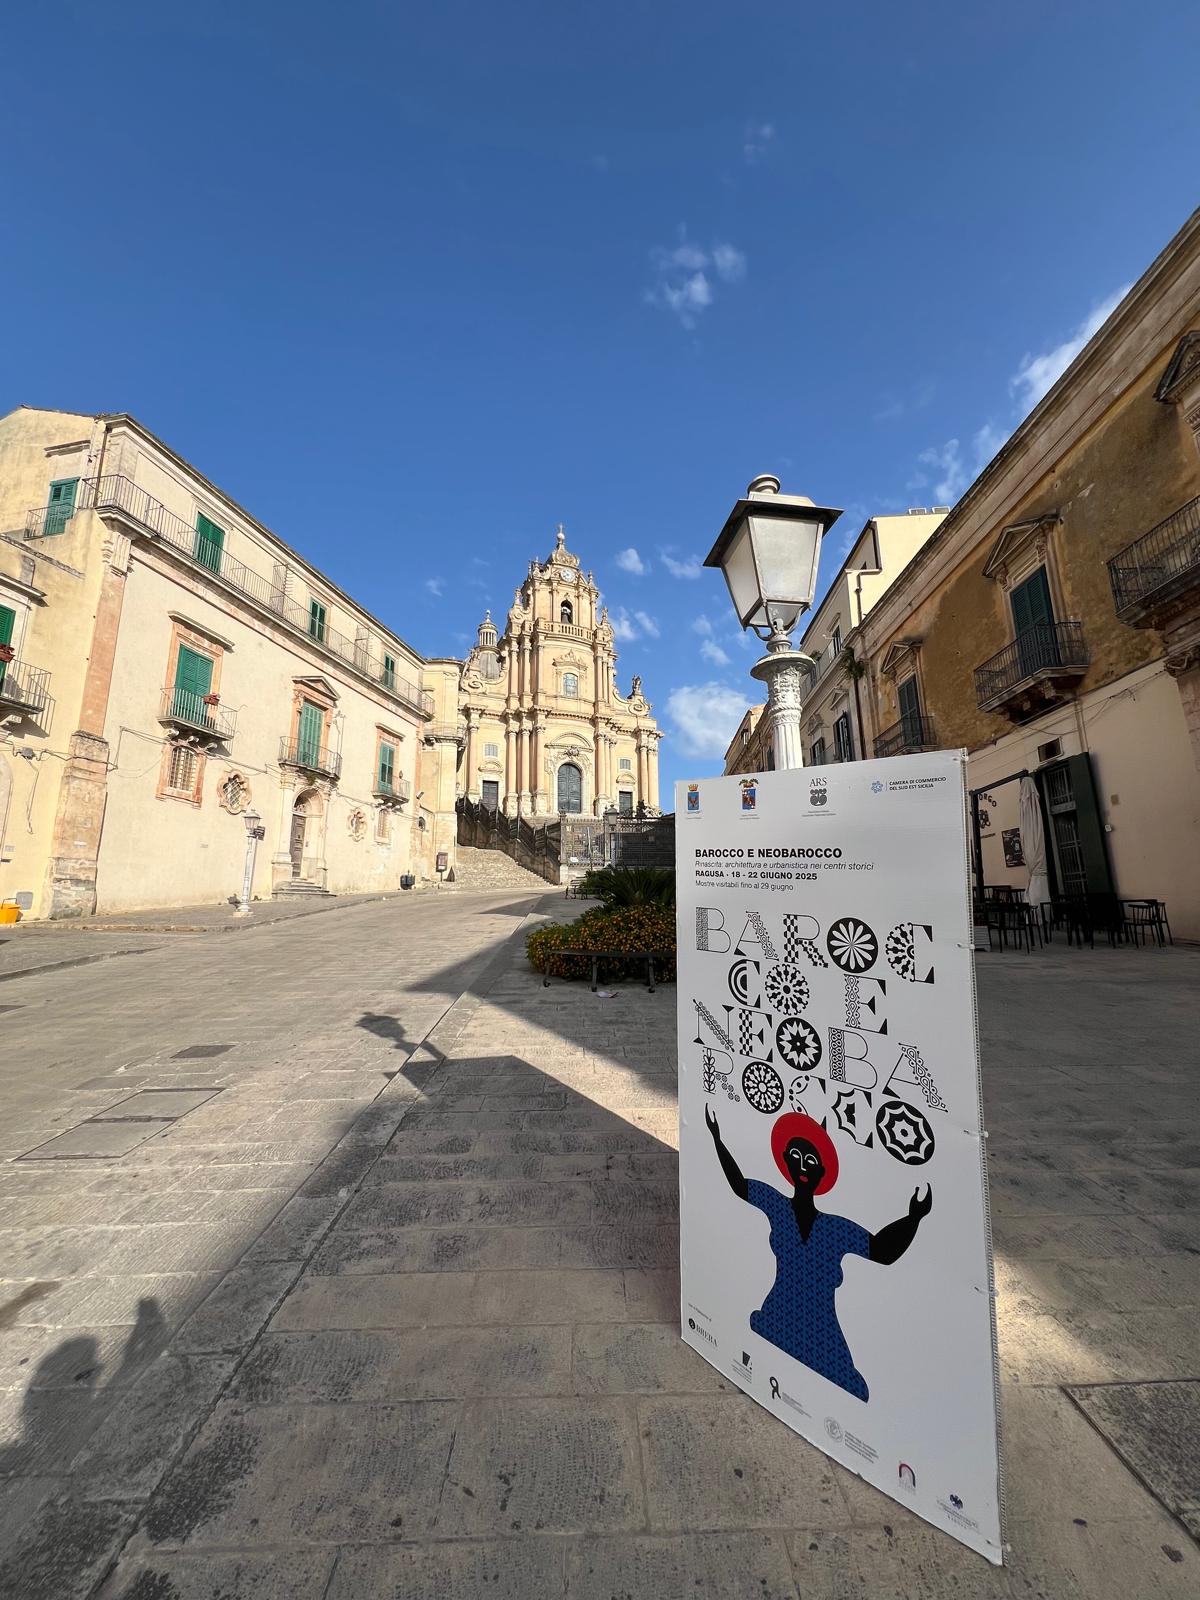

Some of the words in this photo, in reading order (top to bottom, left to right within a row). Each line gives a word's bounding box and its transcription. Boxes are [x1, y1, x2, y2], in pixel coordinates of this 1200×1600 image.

[810, 777, 828, 787] ARS
[978, 793, 997, 808] ORGO
[695, 849, 744, 858] BAROCCO
[748, 849, 754, 858] E
[758, 848, 842, 858] NEOBAROCCO
[848, 863, 874, 871] storici
[771, 883, 793, 891] giugno
